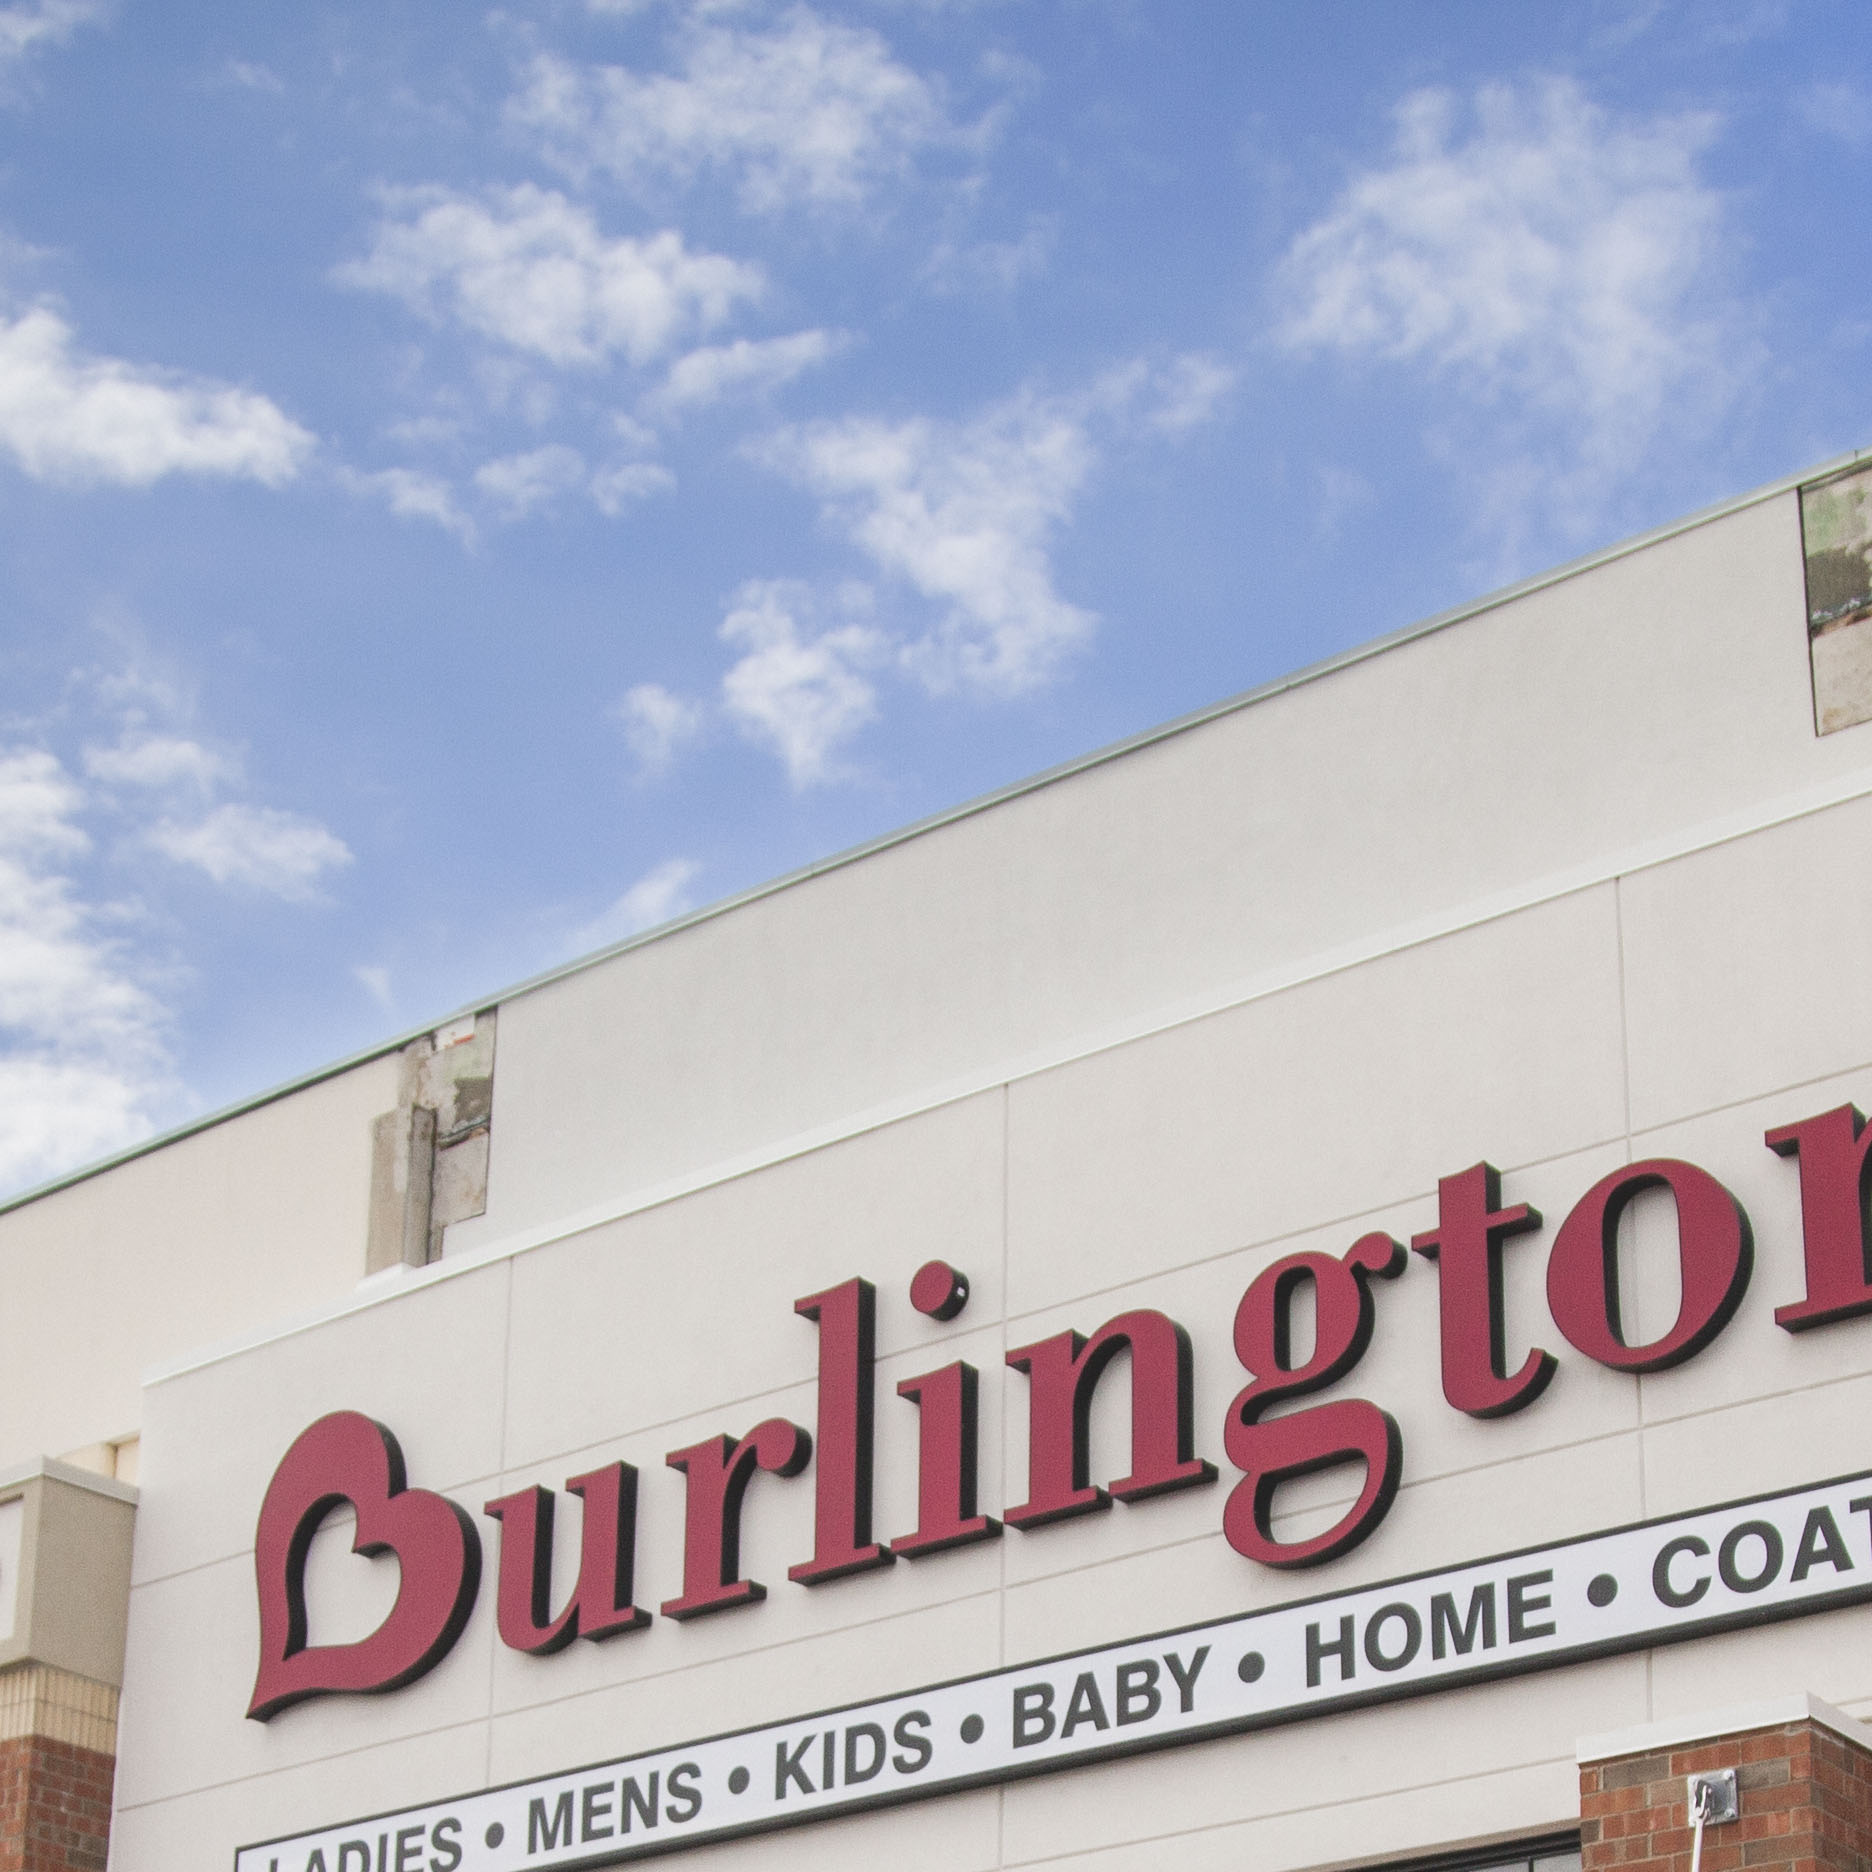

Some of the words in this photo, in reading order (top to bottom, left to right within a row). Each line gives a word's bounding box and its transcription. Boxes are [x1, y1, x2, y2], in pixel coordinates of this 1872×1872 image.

[526, 1762, 703, 1855] MENS
[774, 1709, 934, 1801] KIDS
[1011, 1644, 1212, 1750] BABY
[1304, 1568, 1557, 1688] HOME
